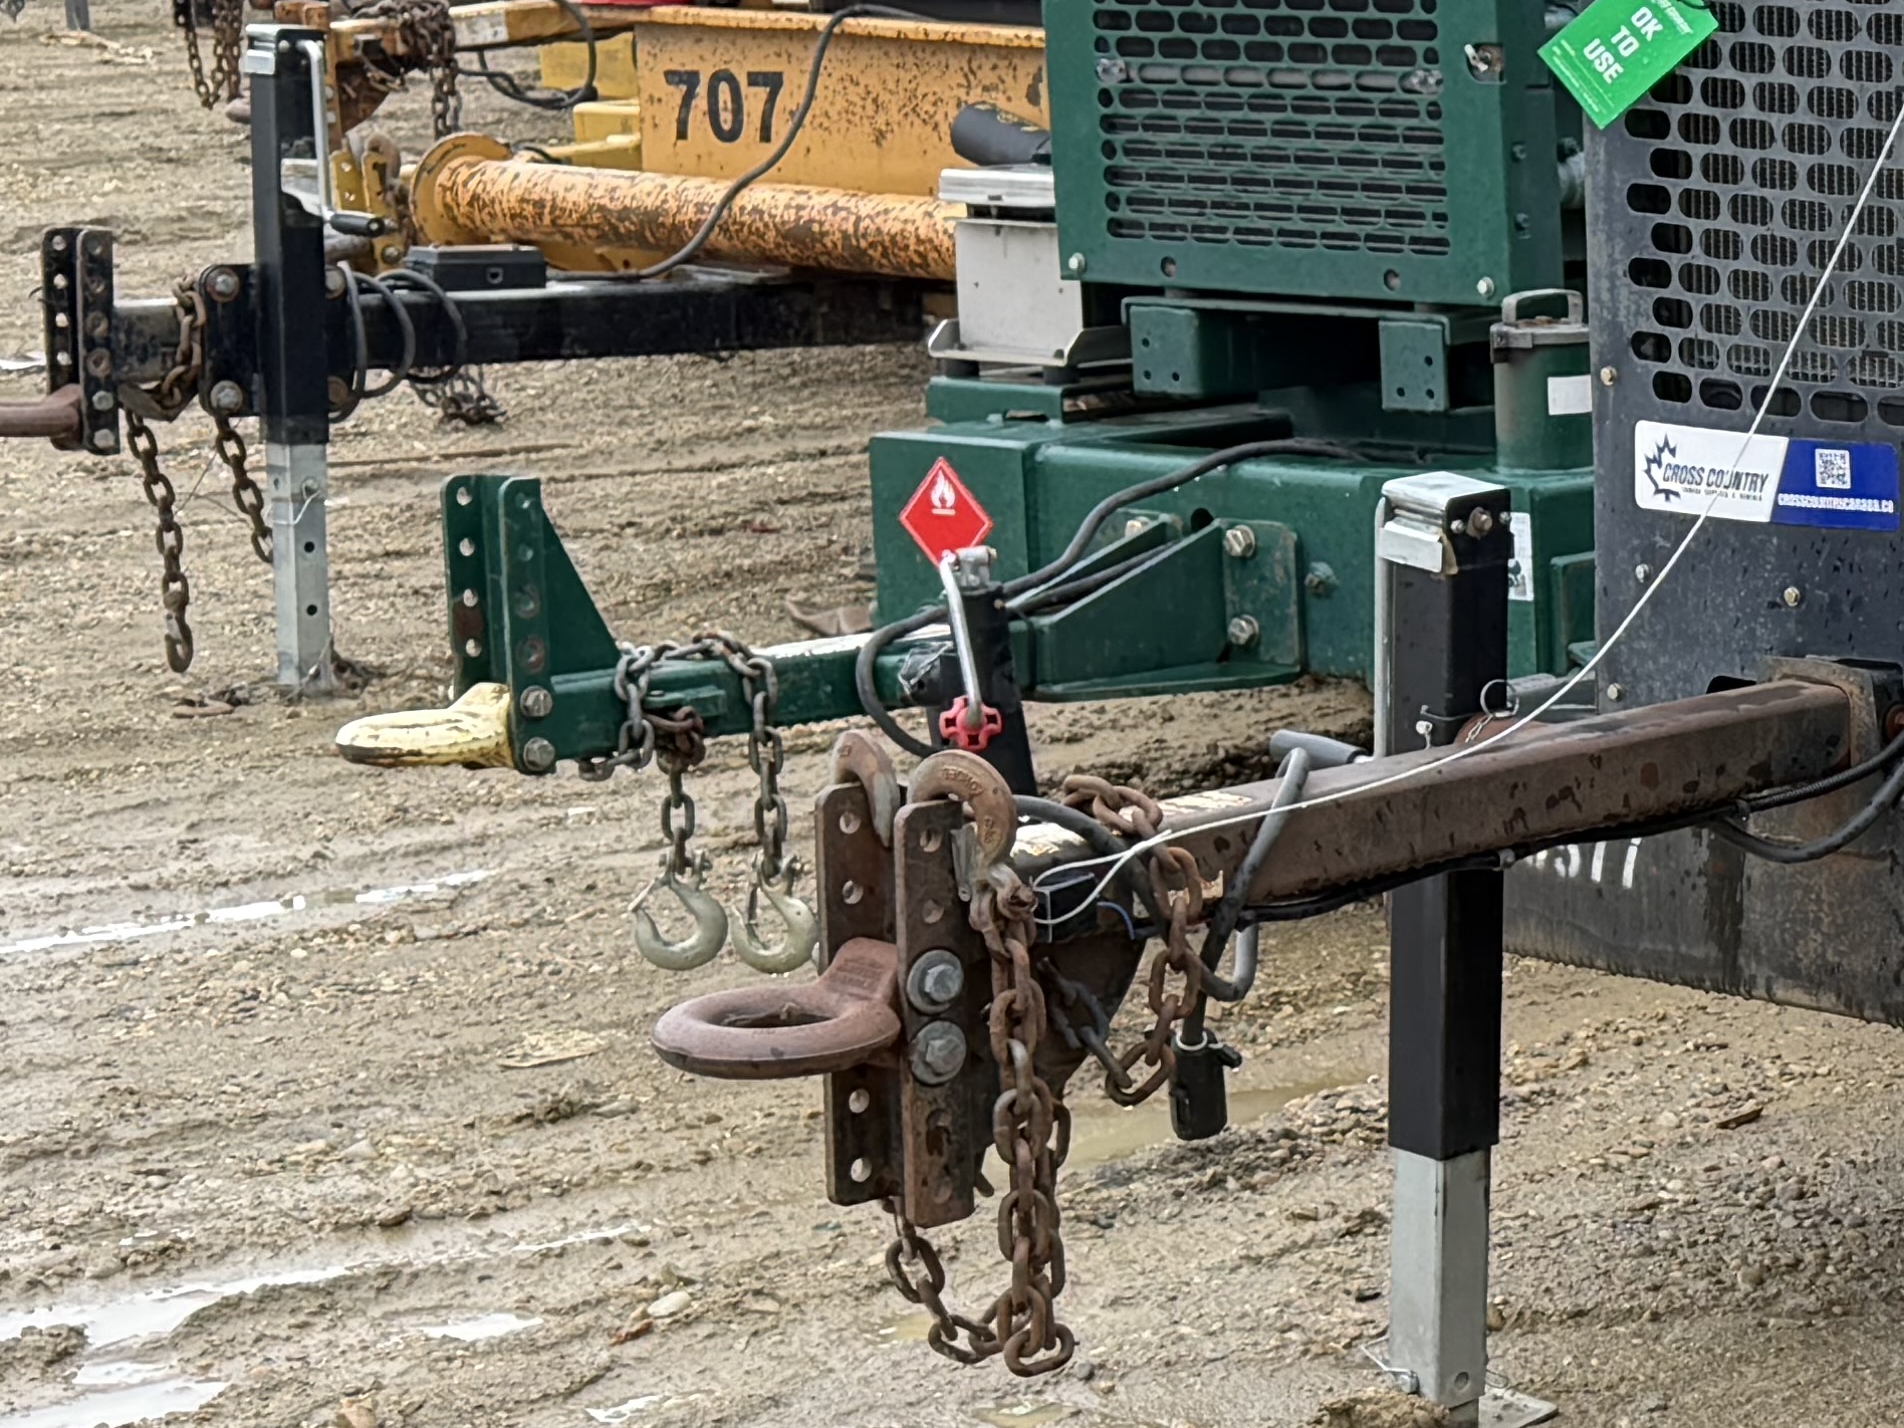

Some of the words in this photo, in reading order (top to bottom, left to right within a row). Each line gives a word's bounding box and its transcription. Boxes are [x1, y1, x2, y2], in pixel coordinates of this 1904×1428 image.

[1610, 24, 1640, 58] TO
[1630, 6, 1664, 42] OK
[1583, 37, 1625, 85] USE
[663, 68, 784, 144] 707
[1662, 462, 1704, 486] CROSS
[1706, 467, 1770, 494] COUNTRY
